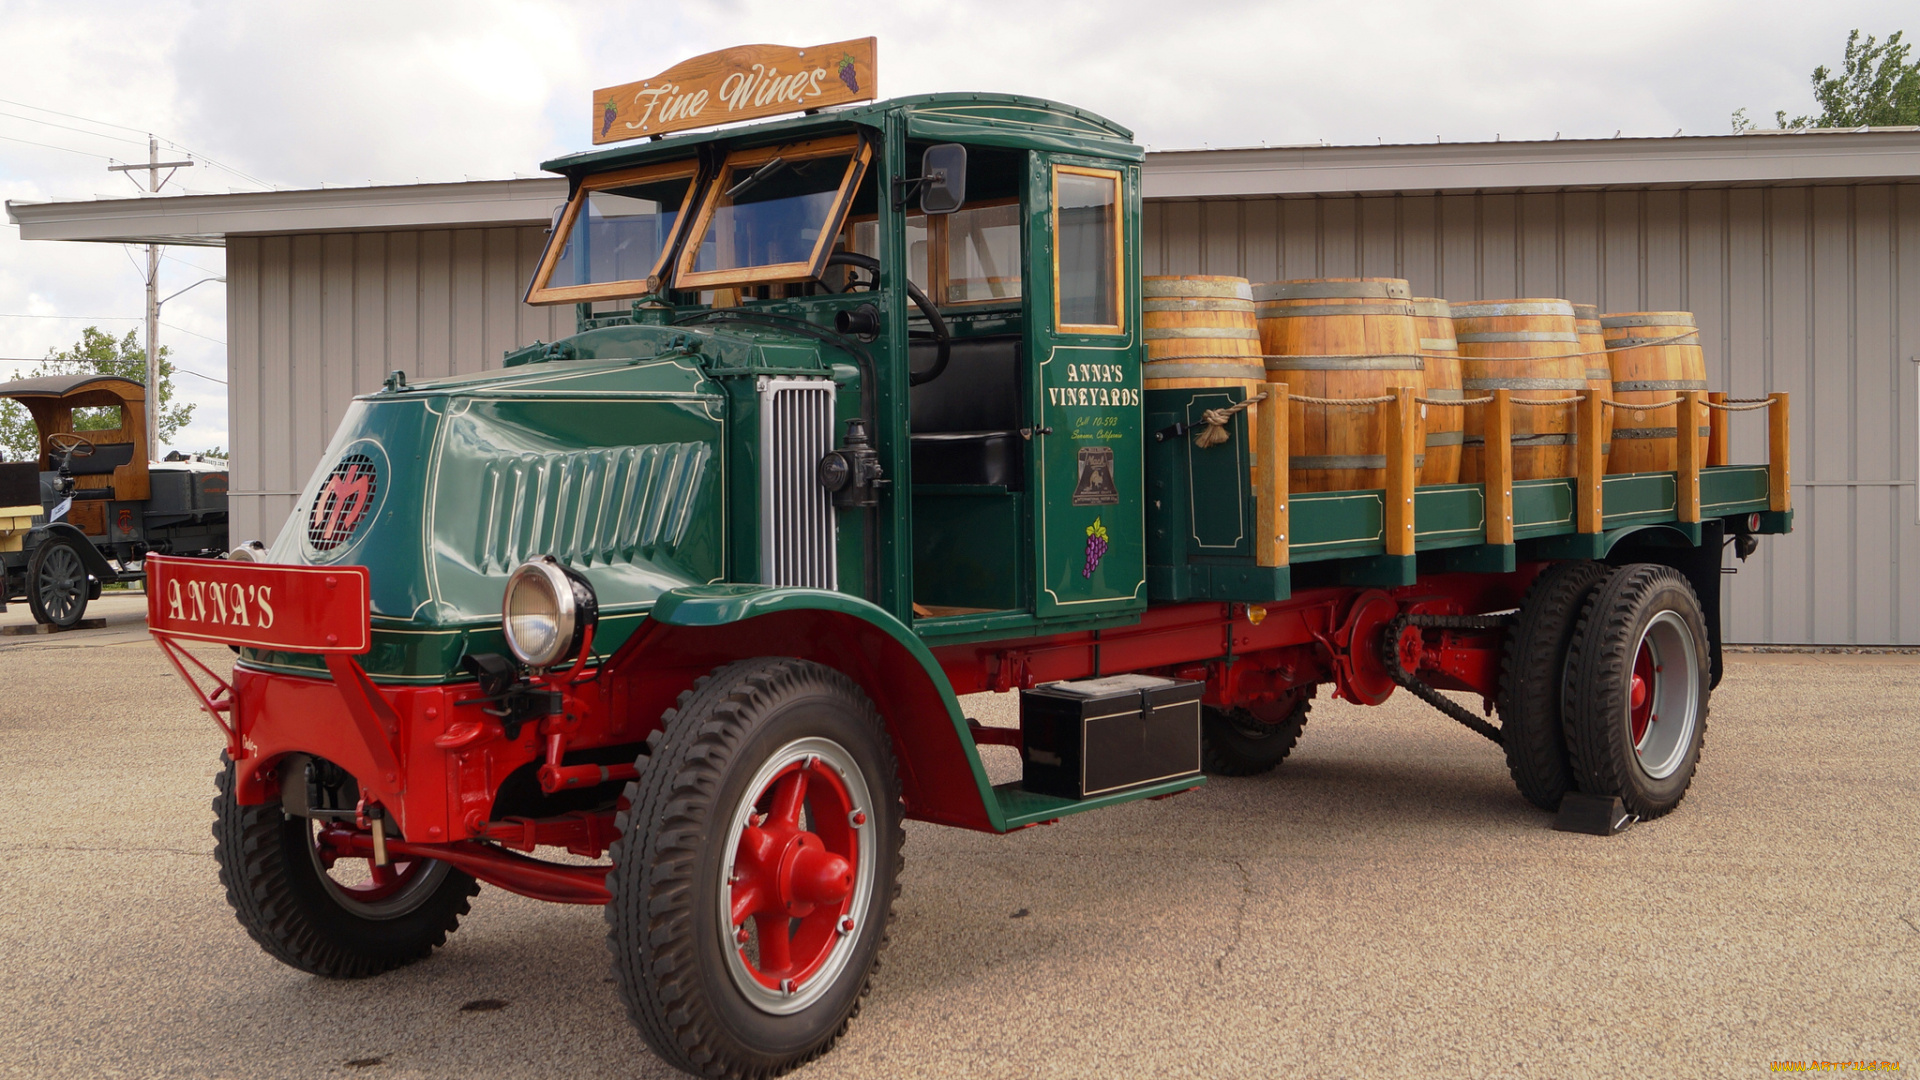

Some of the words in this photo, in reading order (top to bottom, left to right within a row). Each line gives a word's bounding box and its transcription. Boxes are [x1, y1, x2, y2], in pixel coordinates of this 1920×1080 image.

[625, 83, 710, 130] Fine
[718, 63, 827, 113] Wines
[1067, 363, 1123, 383] ANNA'S
[1048, 387, 1139, 407] VINEYARDS
[1075, 416, 1091, 428] Call
[1092, 416, 1118, 427] 10-593
[167, 578, 274, 629] ANNA'S
